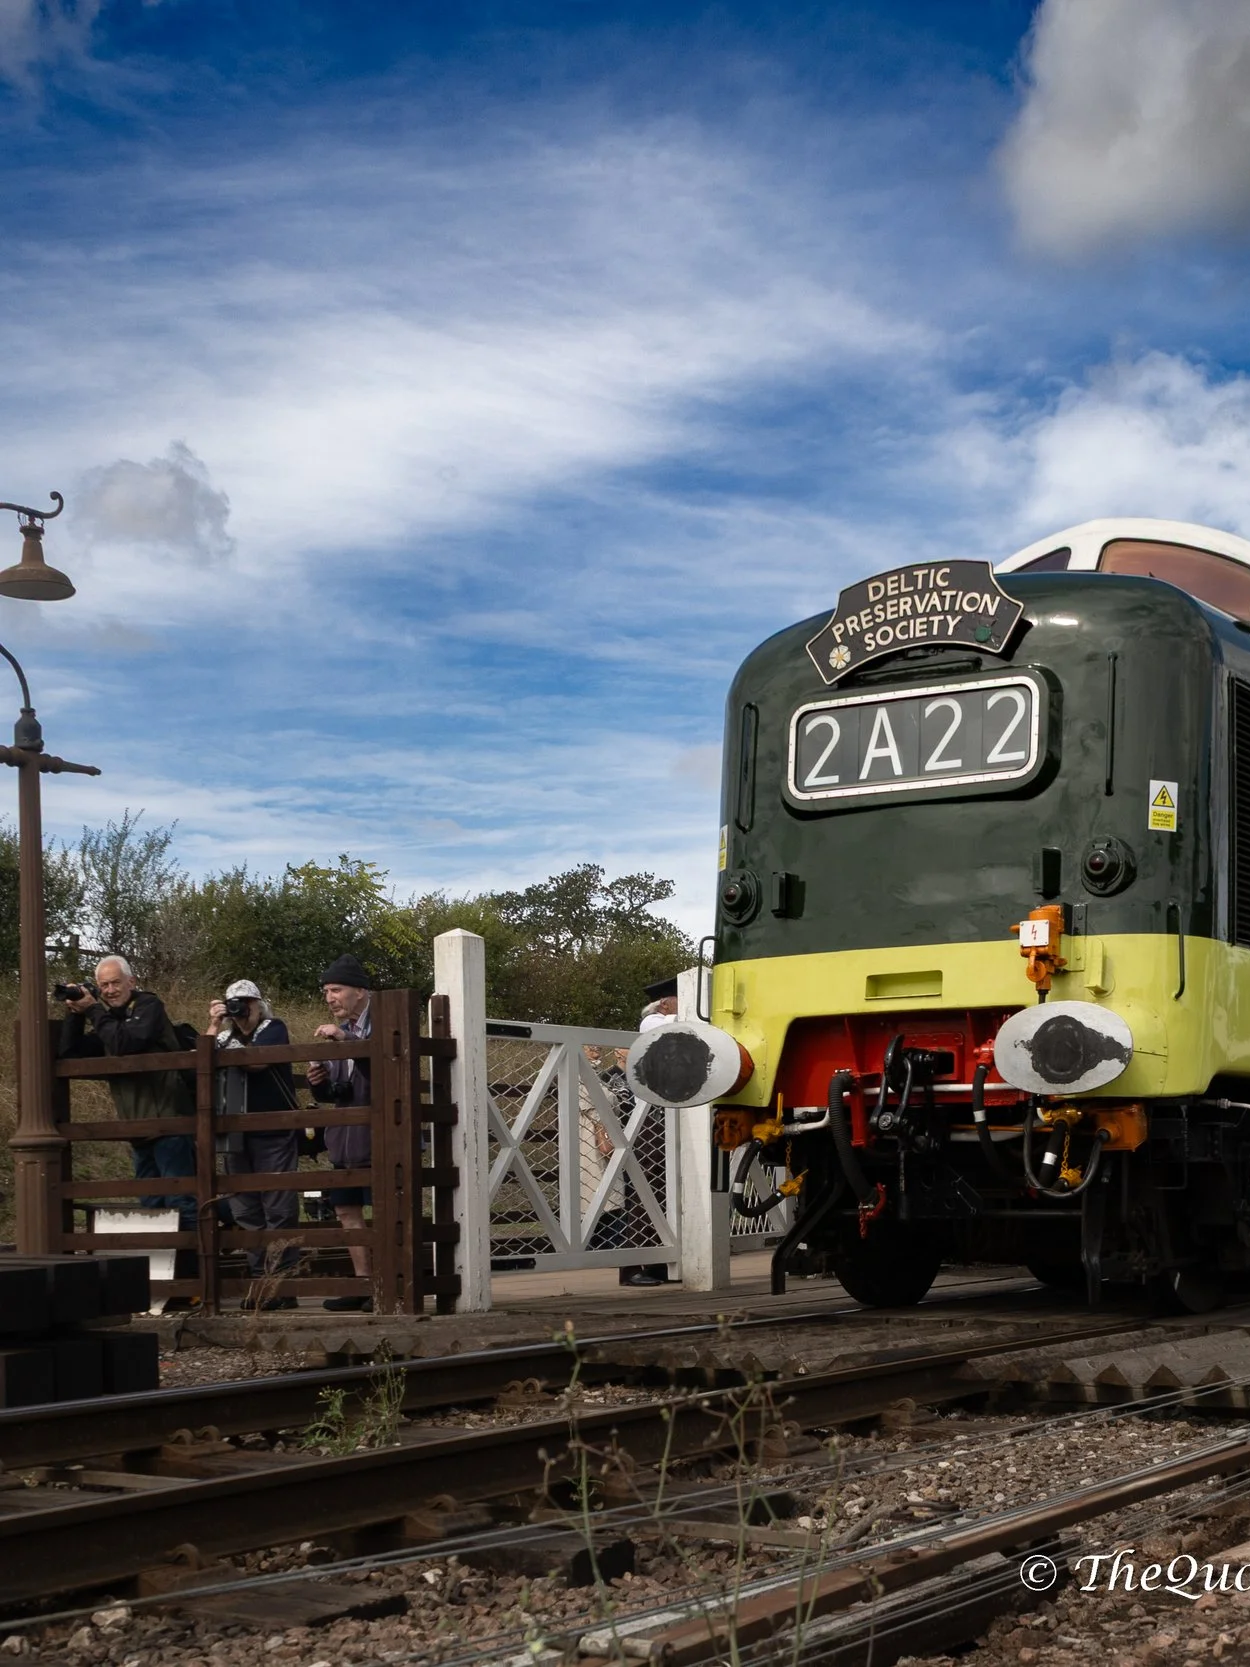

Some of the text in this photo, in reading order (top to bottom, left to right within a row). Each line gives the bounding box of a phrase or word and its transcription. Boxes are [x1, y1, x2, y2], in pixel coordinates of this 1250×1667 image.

[867, 568, 950, 602] DELTIC
[831, 589, 1000, 643] PRESERVATION
[864, 615, 963, 652] SOCIETY
[804, 689, 1026, 787] 2A22
[1153, 811, 1173, 819] Danger
